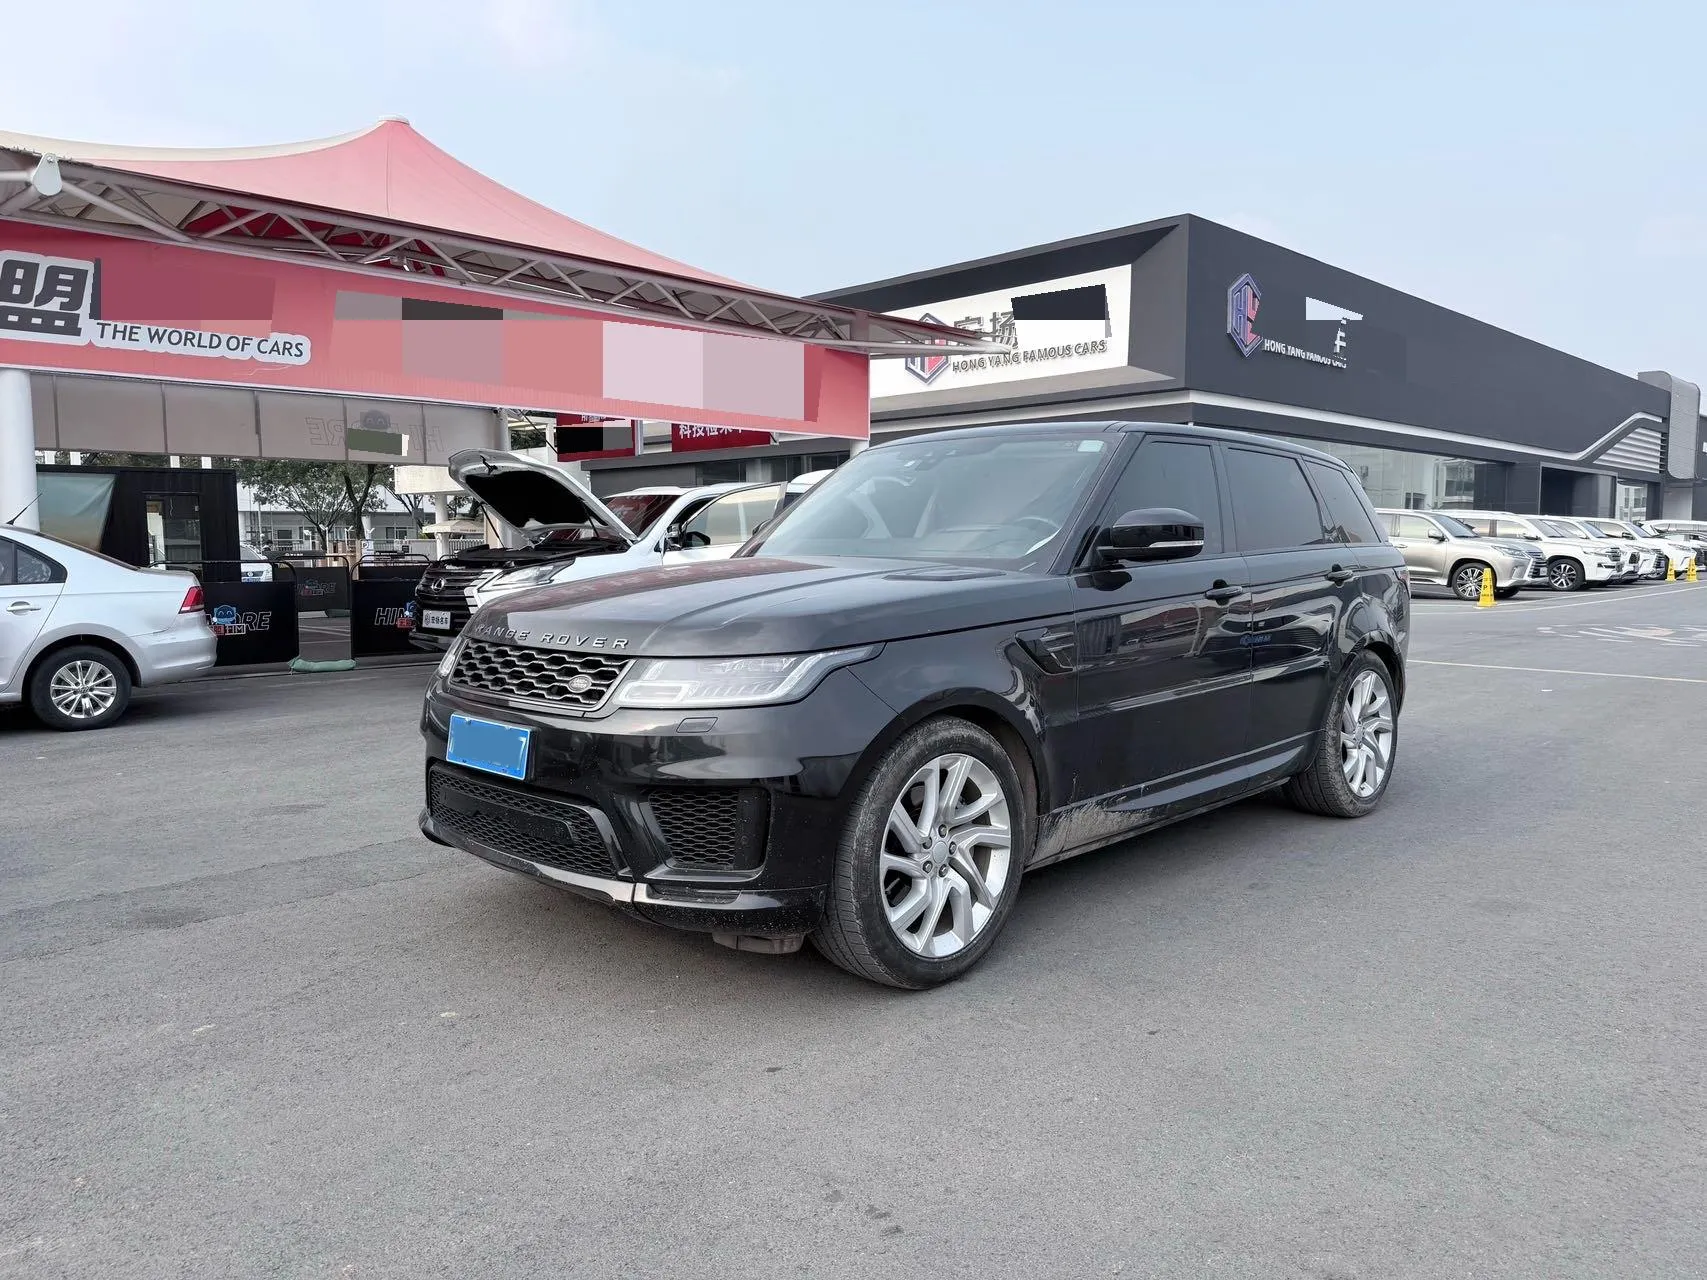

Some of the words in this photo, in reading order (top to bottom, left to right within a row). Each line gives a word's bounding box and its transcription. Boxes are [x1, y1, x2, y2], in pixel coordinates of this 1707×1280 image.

[96, 322, 141, 342] THE
[147, 326, 222, 350] WORLD
[226, 335, 253, 352] OF
[256, 338, 304, 358] CARS
[1264, 338, 1287, 354] HONG
[952, 357, 985, 373] HONG
[988, 351, 1020, 368] YANG
[1023, 343, 1072, 362] FAMOUS
[1074, 338, 1108, 355] CARS
[474, 624, 530, 641] RANGE
[540, 633, 629, 649] ROVER
